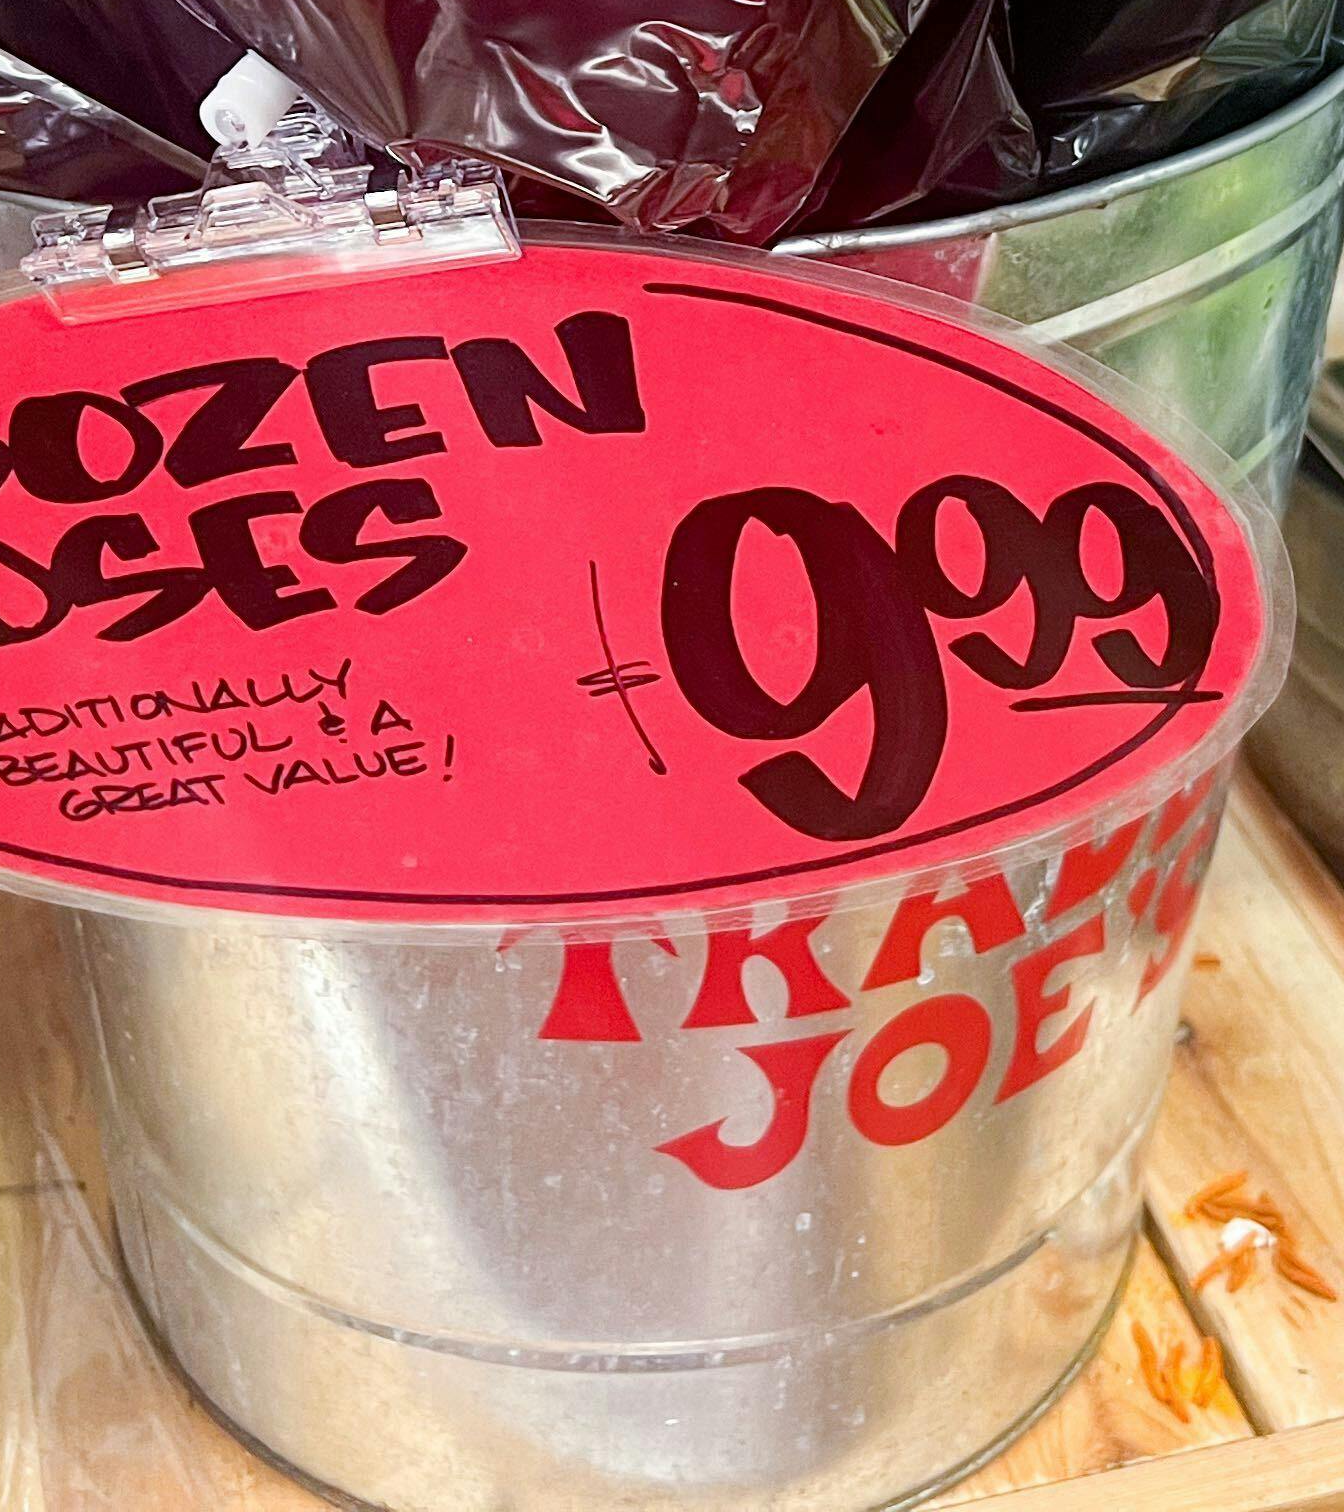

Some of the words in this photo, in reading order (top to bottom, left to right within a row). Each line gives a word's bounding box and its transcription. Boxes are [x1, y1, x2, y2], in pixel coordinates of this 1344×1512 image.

[370, 699, 413, 737] A
[58, 773, 227, 822] GREAT
[243, 734, 455, 795] VALUE!
